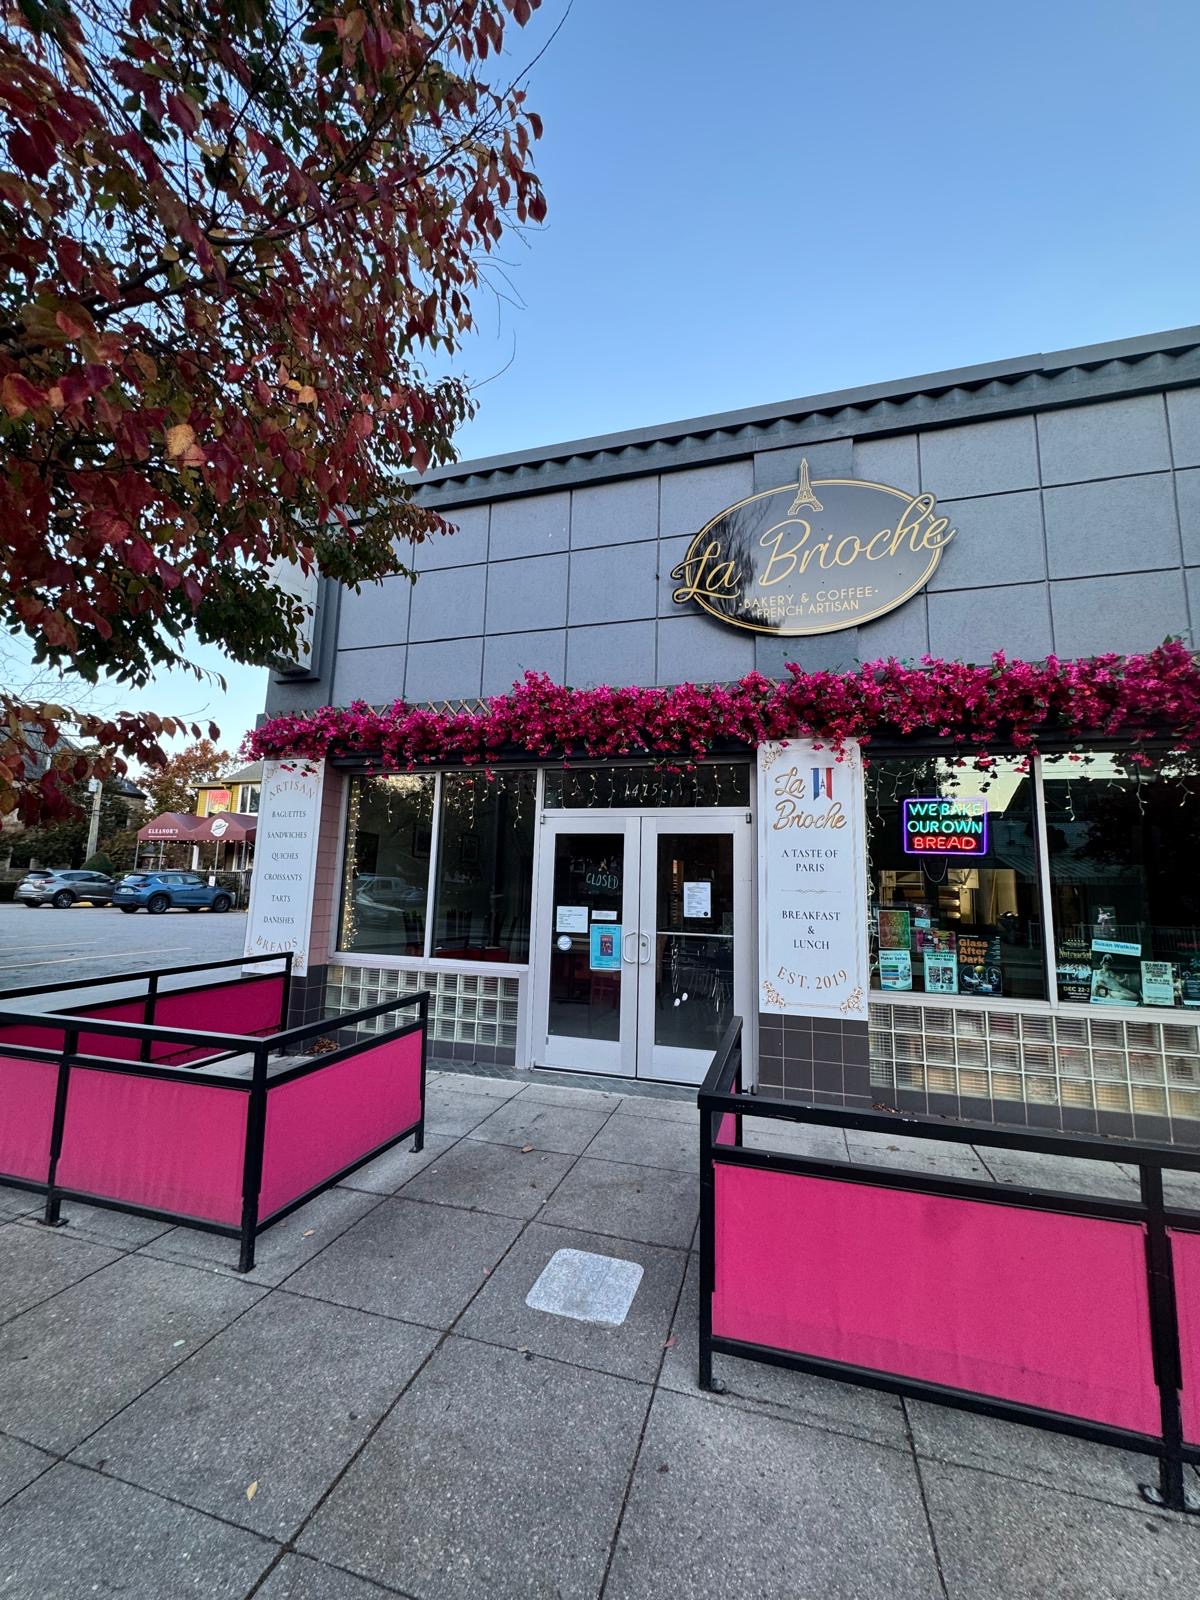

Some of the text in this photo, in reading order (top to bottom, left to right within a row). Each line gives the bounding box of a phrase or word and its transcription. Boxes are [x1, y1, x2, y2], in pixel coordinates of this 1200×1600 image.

[671, 493, 957, 603] La Brioche
[744, 586, 873, 609] BAKERY & COFFEE
[757, 600, 859, 618] FRENCH ARTISAN
[774, 766, 805, 799] La
[269, 780, 315, 800] ARTISAN
[271, 810, 306, 818] BAGUETTES
[773, 799, 847, 831] Brioche
[908, 803, 981, 816] WE BAKE
[907, 820, 982, 834] OUR OWN
[267, 831, 307, 839] SANDWICHES
[913, 836, 977, 850] BREAD
[271, 852, 299, 860] QUICHES
[781, 849, 838, 858] A TASTE OF
[795, 863, 825, 872] PARIS
[264, 872, 302, 881] CROISSANTS
[586, 872, 619, 890] CLOSED
[271, 894, 291, 903] TARTS
[263, 916, 295, 924] DANISHES
[782, 910, 840, 921] BREAKFAST
[807, 925, 815, 935] &
[256, 935, 298, 952] BREADS
[793, 939, 830, 950] LUNCH
[959, 939, 988, 948] Glass
[959, 947, 987, 955] After
[959, 955, 985, 964] Dark
[777, 966, 847, 989] EST. 2019
